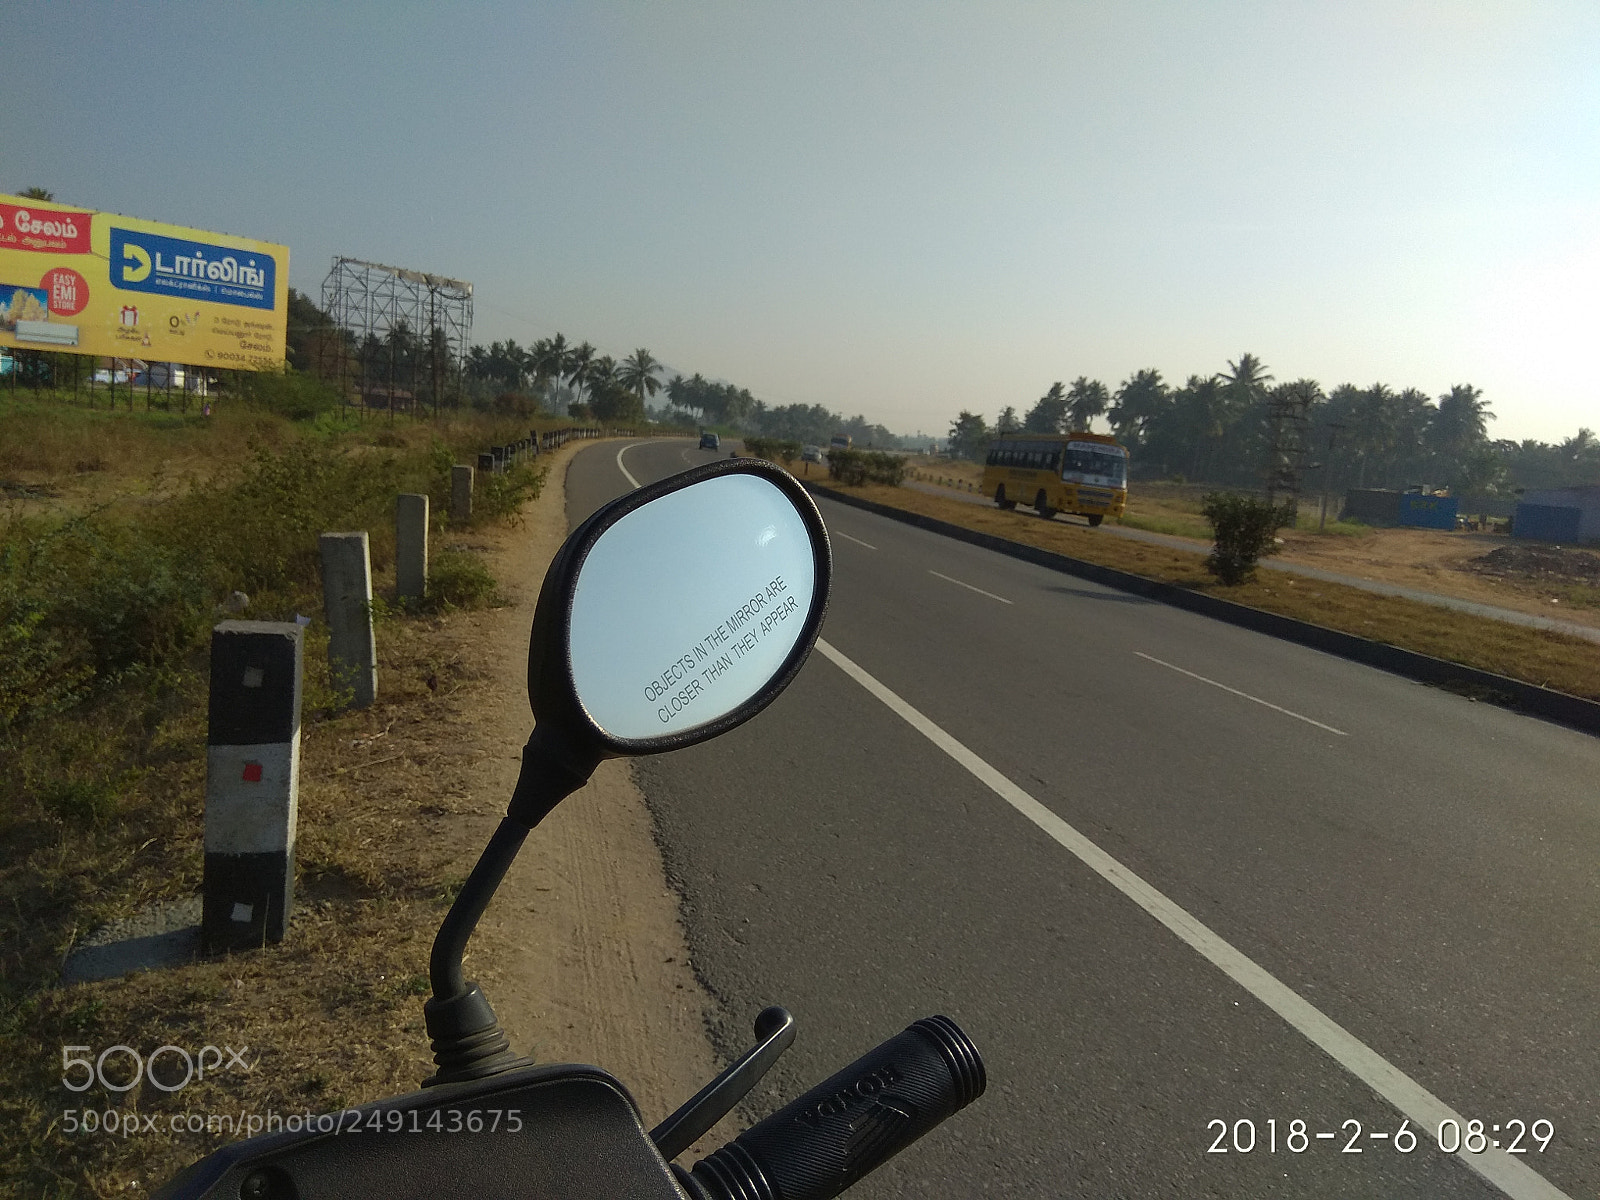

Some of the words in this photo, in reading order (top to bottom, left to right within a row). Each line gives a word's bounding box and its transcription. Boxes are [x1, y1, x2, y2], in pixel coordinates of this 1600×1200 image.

[15, 210, 78, 239] சேலம்
[53, 273, 76, 284] EASY
[155, 250, 265, 288] டார்லிங்
[53, 285, 77, 300] EMI
[53, 300, 75, 310] STORE
[644, 653, 695, 702] OBJECTS
[692, 642, 707, 662] IN
[704, 625, 730, 652] THE
[725, 593, 768, 634] MIRROR
[765, 575, 788, 601] ARE
[657, 679, 704, 724] CLOSER
[702, 652, 734, 684] THAN
[730, 628, 759, 660] THEY
[761, 595, 799, 637] APPEAR
